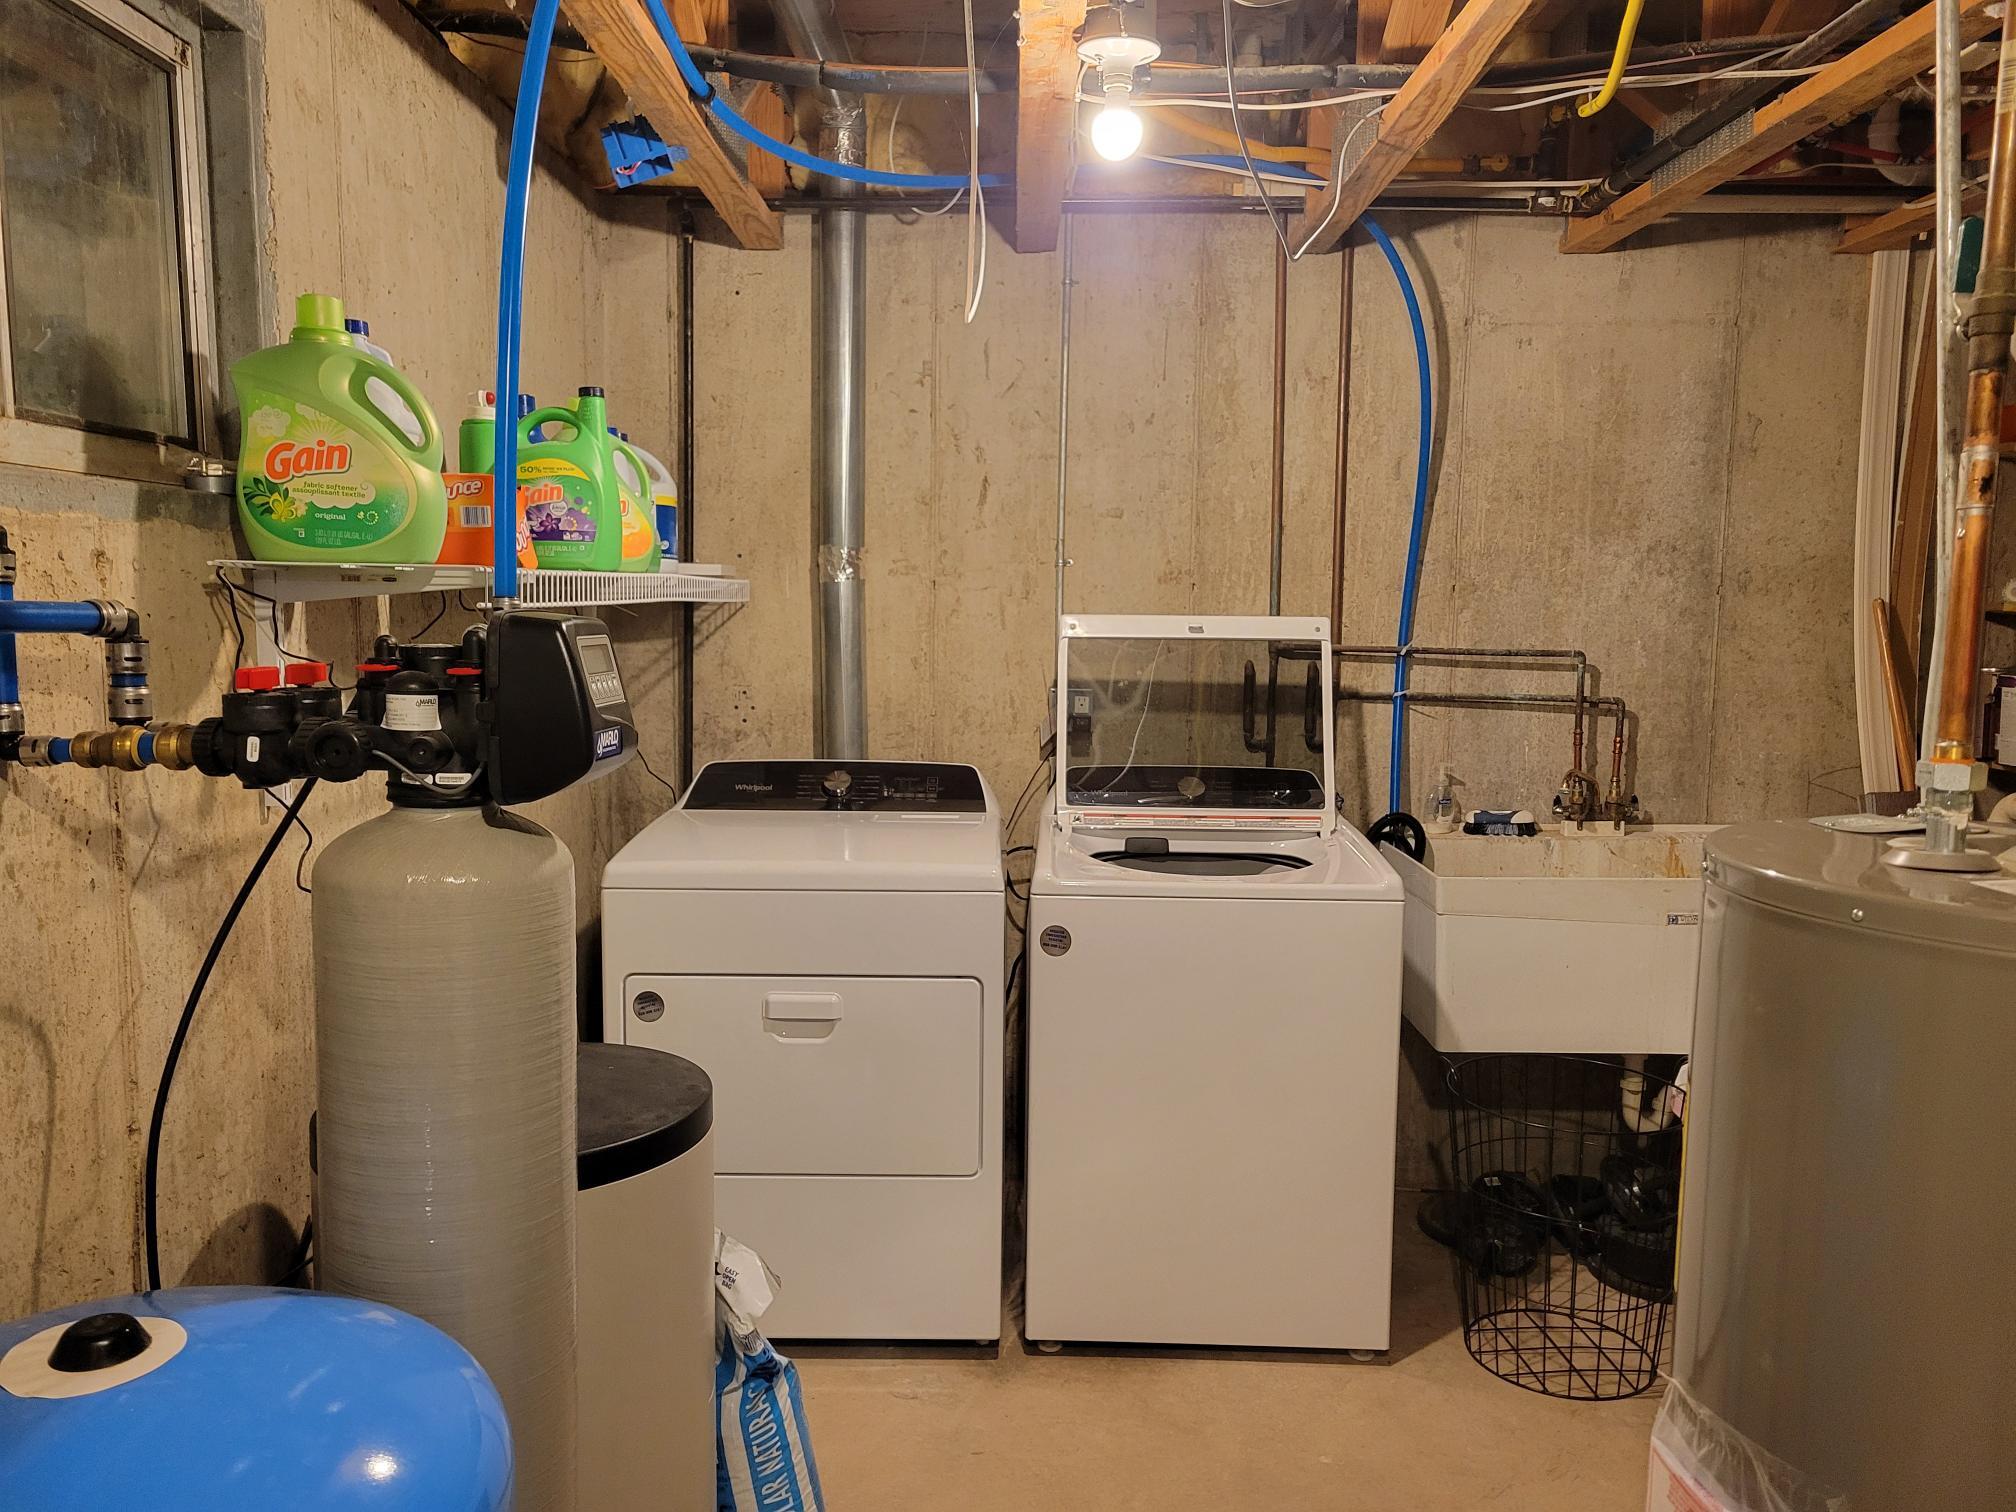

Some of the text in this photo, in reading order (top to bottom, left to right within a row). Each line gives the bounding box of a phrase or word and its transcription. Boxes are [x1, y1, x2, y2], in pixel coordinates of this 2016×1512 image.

[265, 439, 349, 481] Gain
[303, 481, 358, 492] fabric softener
[446, 480, 482, 499] unce
[292, 487, 366, 498] assouplissant textile
[314, 512, 346, 521] original
[735, 784, 773, 792] Whirlpool
[725, 1266, 740, 1277] EASY
[722, 1272, 737, 1285] OPEN
[721, 1279, 732, 1290] BAG
[762, 1471, 797, 1512] LAR
